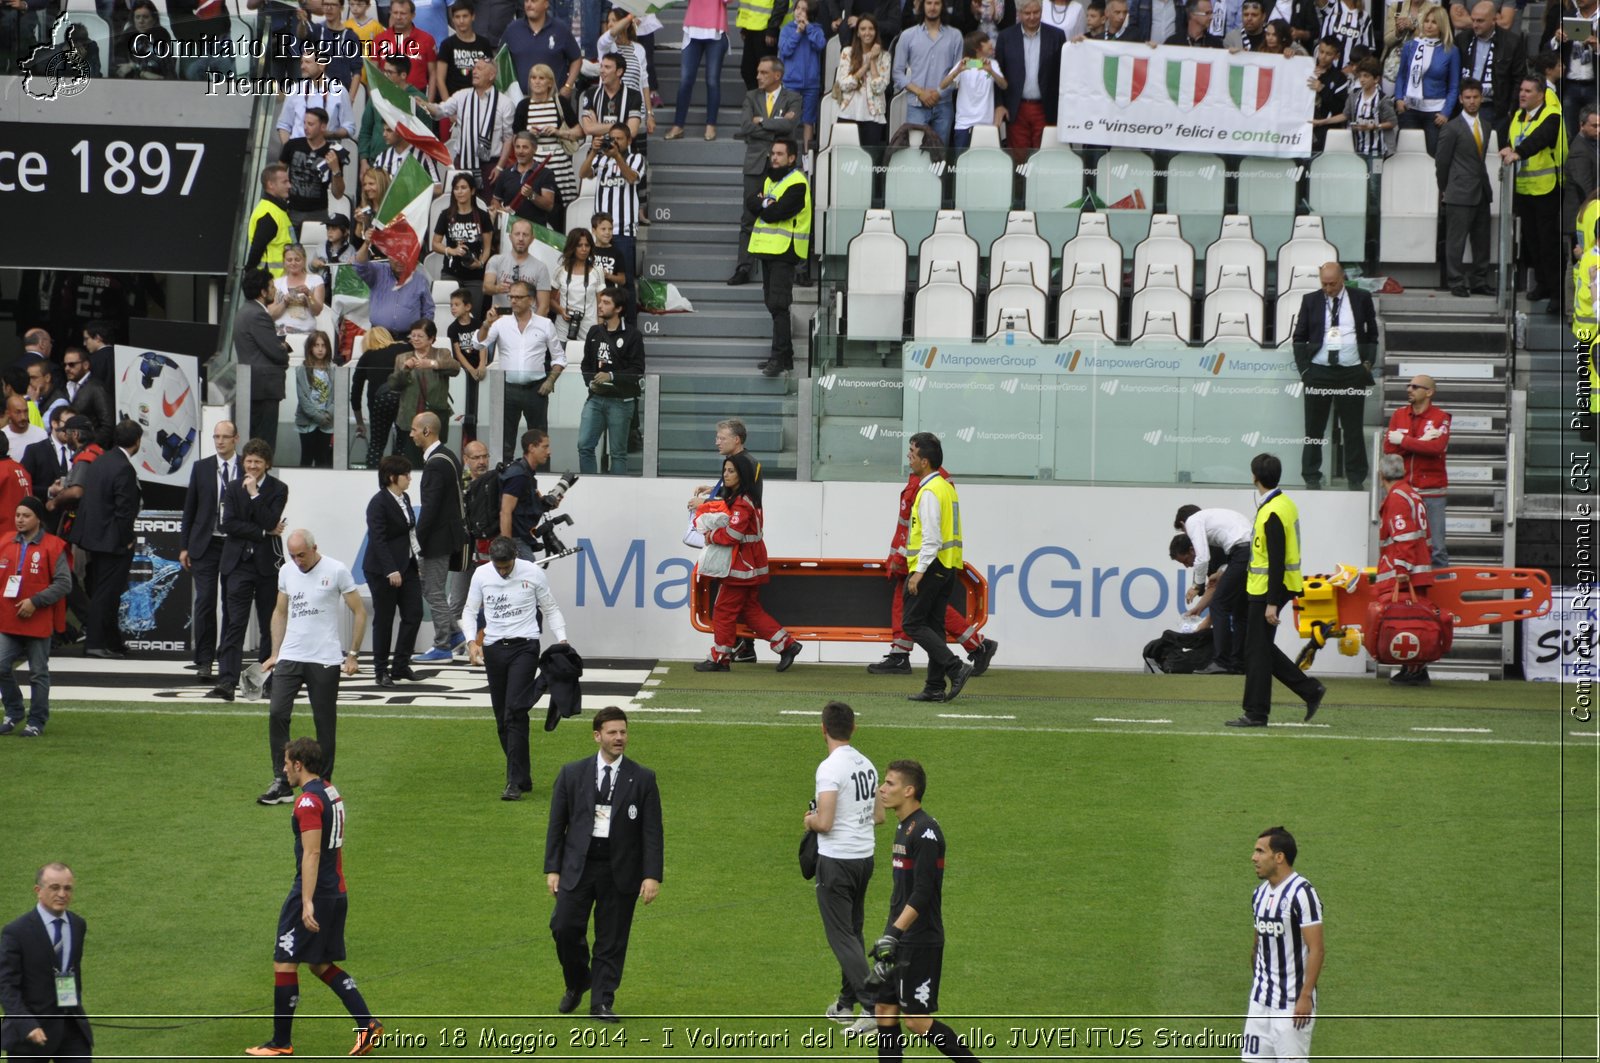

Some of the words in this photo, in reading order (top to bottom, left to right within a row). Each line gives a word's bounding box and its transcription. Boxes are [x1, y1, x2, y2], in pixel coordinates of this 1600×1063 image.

[1333, 23, 1360, 39] Jeep
[1084, 121, 1094, 130] e
[1176, 125, 1214, 139] felici
[1218, 130, 1227, 140] e
[1232, 130, 1301, 145] contenti
[71, 139, 205, 196] 1897
[601, 175, 625, 188] Jeep
[655, 208, 671, 220] 06
[649, 264, 666, 276] 05
[644, 321, 660, 333] 04
[940, 353, 1037, 368] ManpowerGroup
[1084, 356, 1180, 371] ManpowerGroup
[1228, 359, 1299, 373] ManpowerG
[838, 378, 904, 390] ManpowerGroup
[928, 380, 995, 391] ManpowerGroup
[1020, 382, 1088, 393] ManpowerGroup
[1120, 384, 1187, 395] ManpowerGroup
[1212, 385, 1279, 396] ManpowerGroup
[1305, 386, 1373, 397] ManpowerGroup
[976, 431, 1043, 442] ManpowerGroup
[1164, 434, 1231, 446] ManpowerGroup
[1261, 436, 1329, 447] ManpowerGroup
[133, 520, 183, 532] ERADE
[126, 640, 185, 651] ERADE
[851, 769, 876, 801] 102
[328, 801, 345, 849] 10
[1254, 916, 1285, 938] Jeep
[1244, 1033, 1260, 1055] 10
